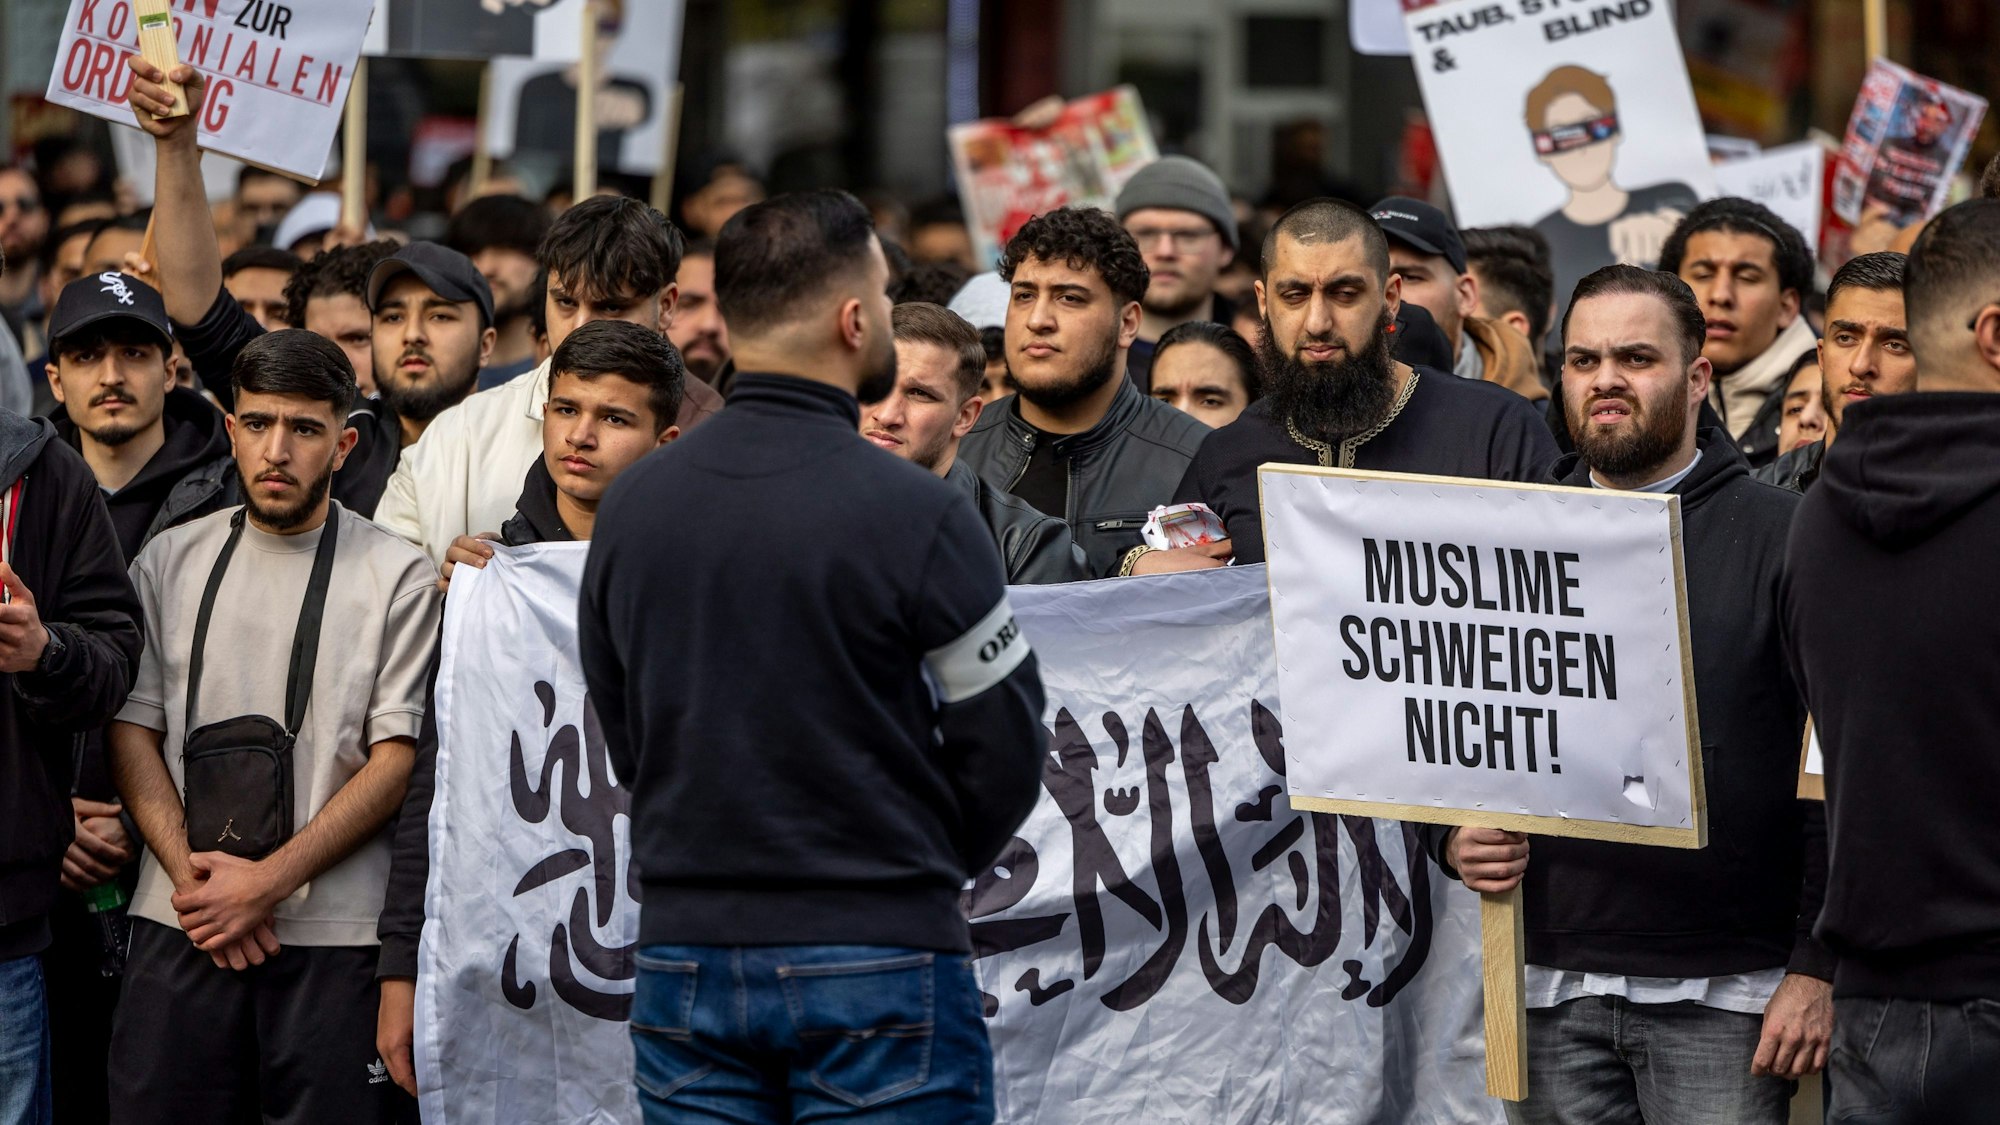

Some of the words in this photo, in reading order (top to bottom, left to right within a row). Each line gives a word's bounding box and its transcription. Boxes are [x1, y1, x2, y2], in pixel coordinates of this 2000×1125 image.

[234, 0, 292, 40] ZUR
[1431, 47, 1459, 73] &
[1543, 0, 1653, 42] BLIND
[1362, 538, 1585, 617] MUSLIME
[1339, 615, 1617, 700] SCHWEIGEN
[1404, 697, 1562, 774] NICHT!
